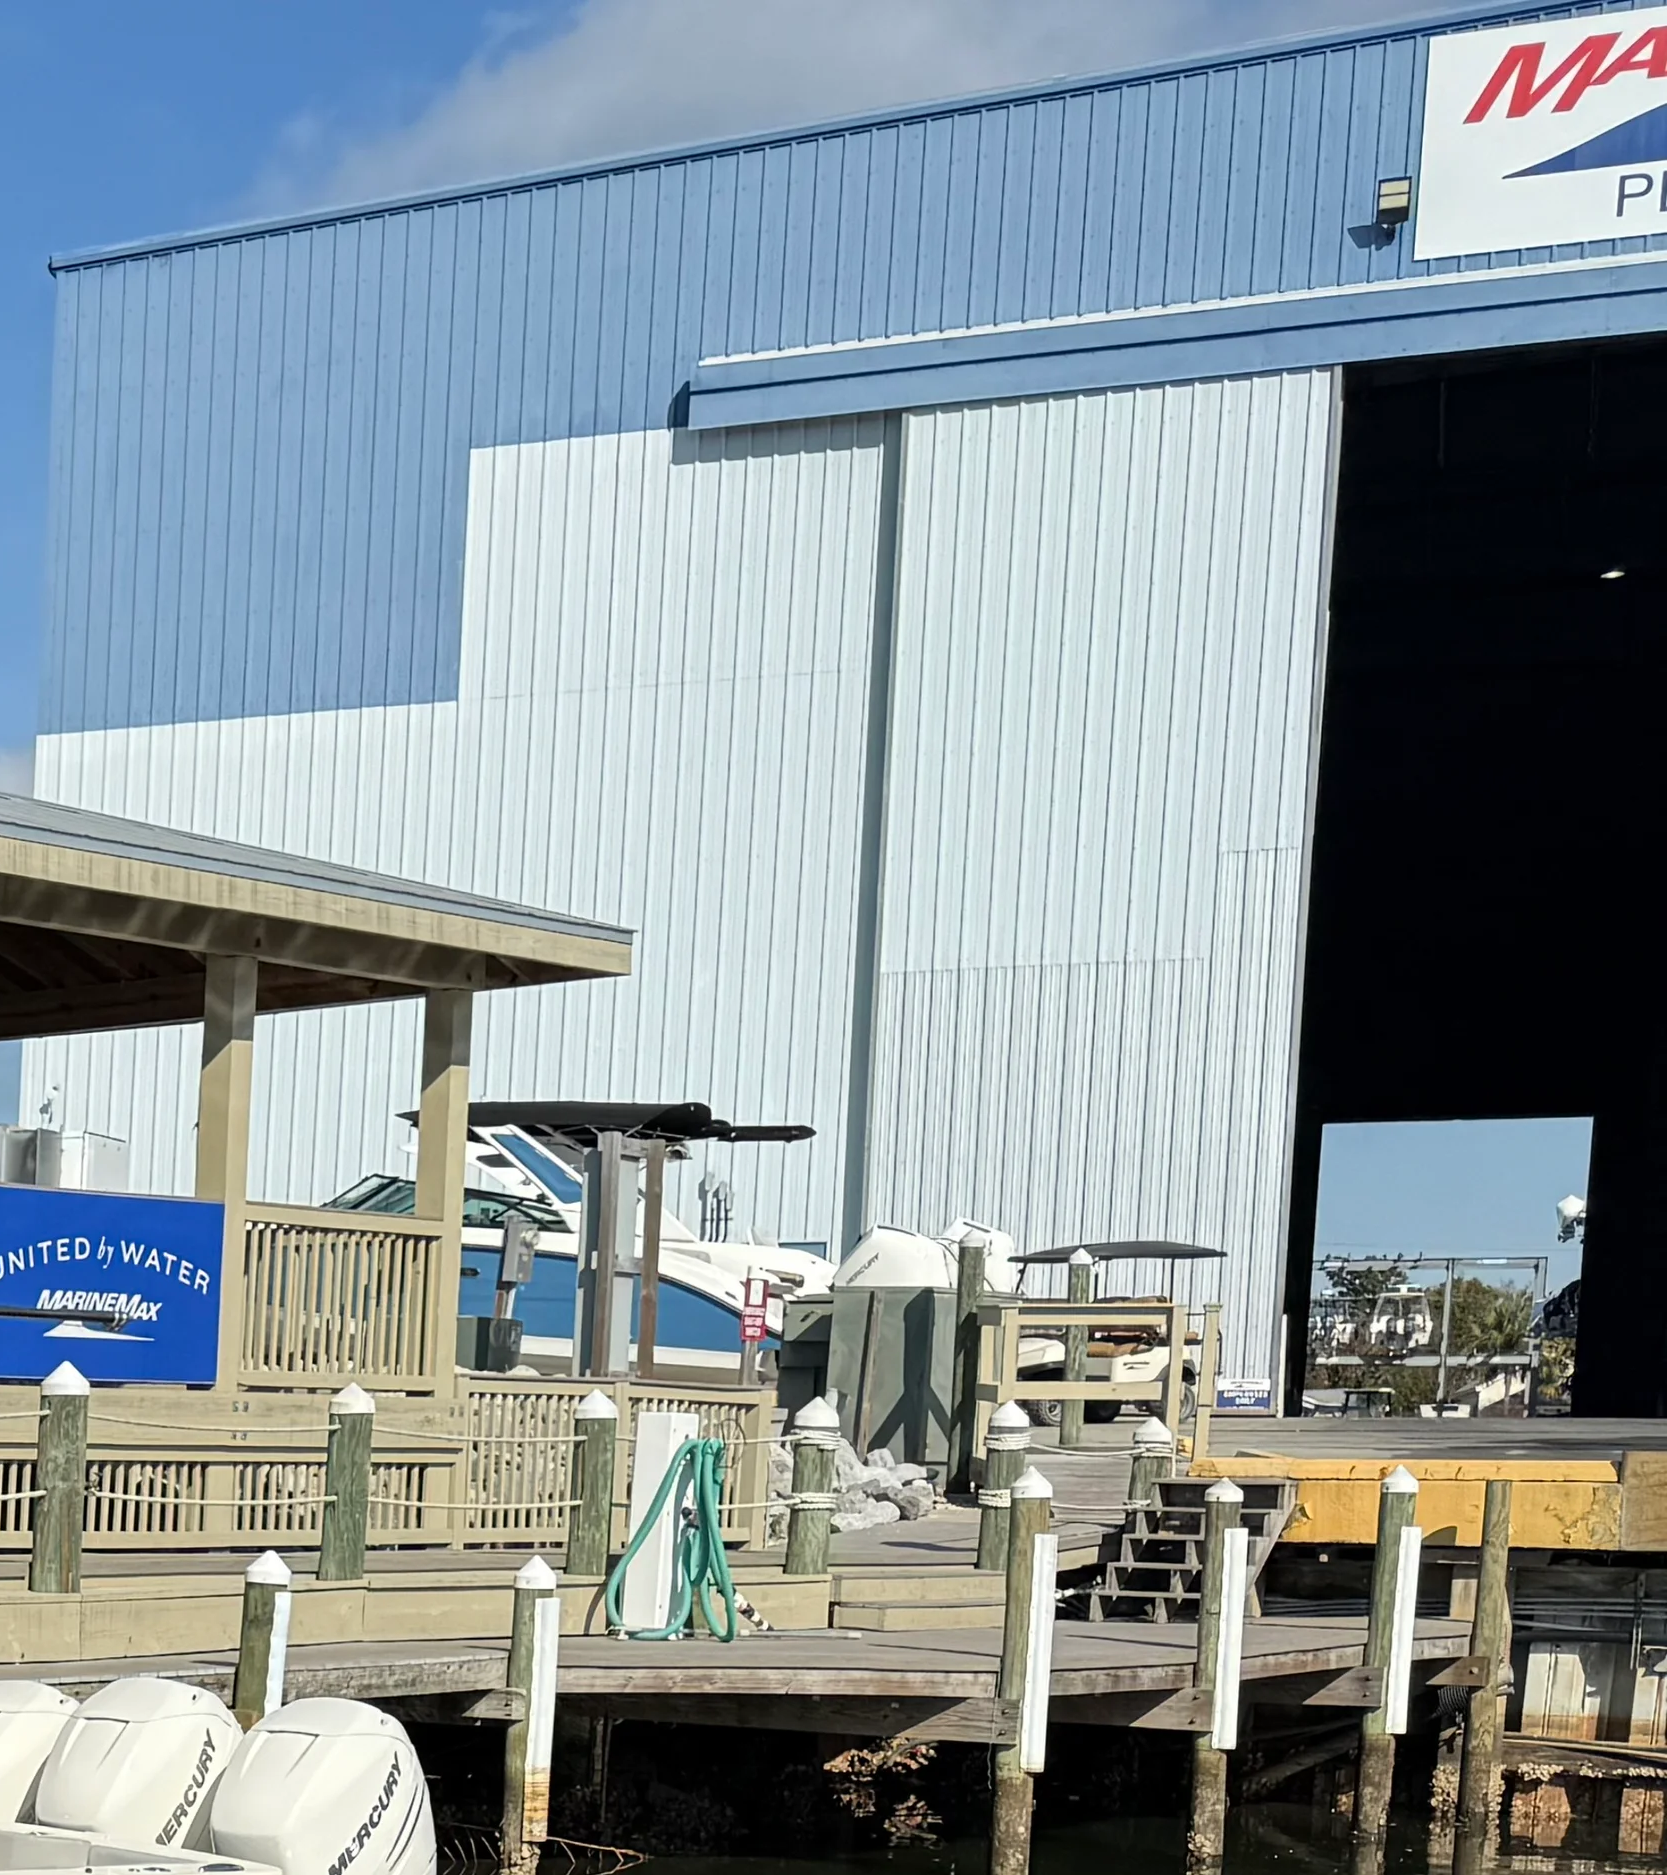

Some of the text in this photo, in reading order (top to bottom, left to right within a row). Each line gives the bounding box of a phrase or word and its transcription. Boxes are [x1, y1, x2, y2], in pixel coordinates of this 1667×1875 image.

[1616, 170, 1667, 217] P
[97, 1236, 114, 1269] by
[120, 1240, 211, 1295] WATER
